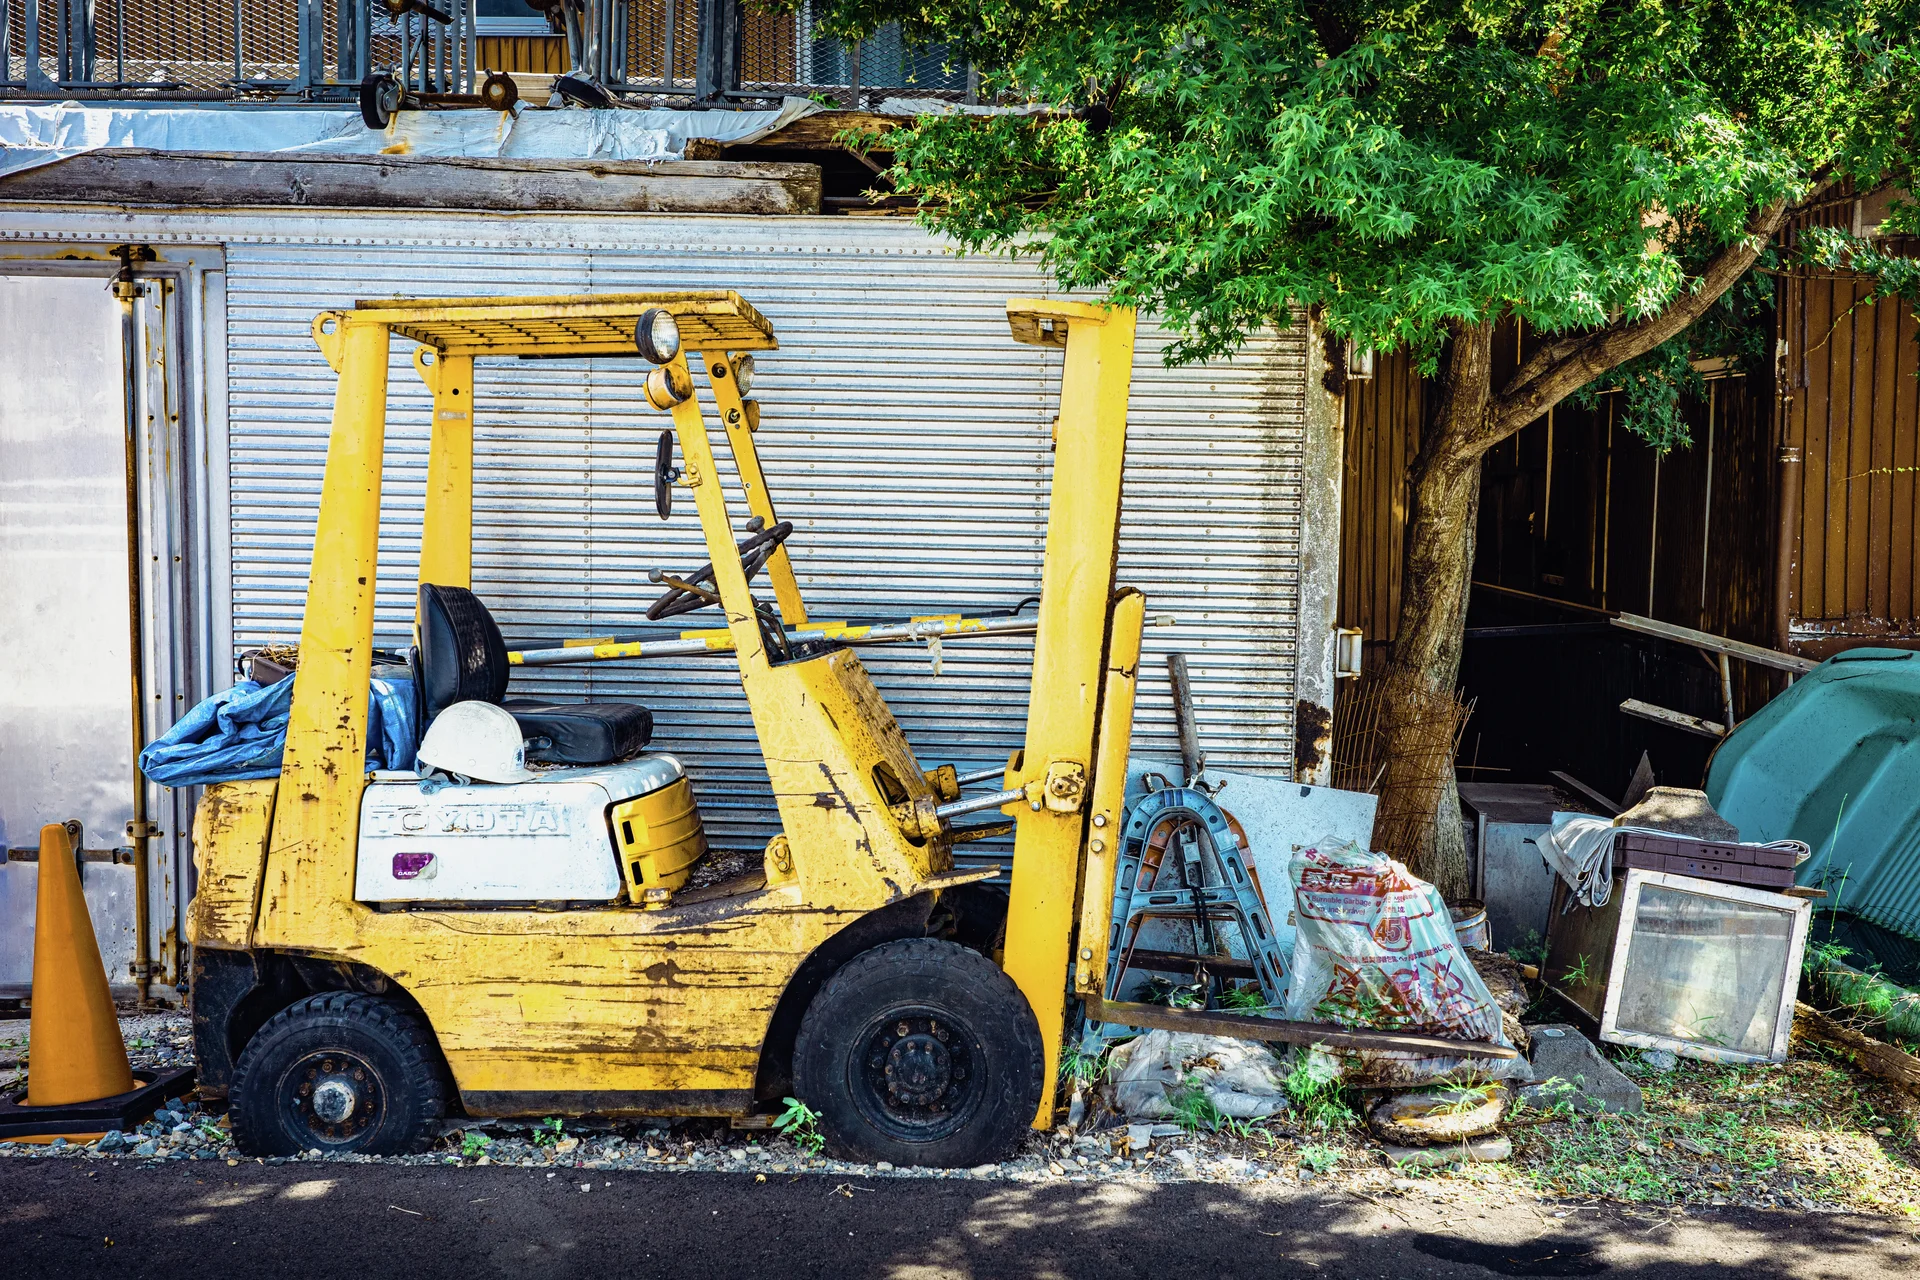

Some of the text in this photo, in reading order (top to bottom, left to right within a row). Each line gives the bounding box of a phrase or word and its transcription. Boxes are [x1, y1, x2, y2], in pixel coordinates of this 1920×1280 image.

[371, 809, 559, 833] TOYOTA
[1312, 895, 1371, 906] Burnable Garbage
[1374, 918, 1403, 944] 45
